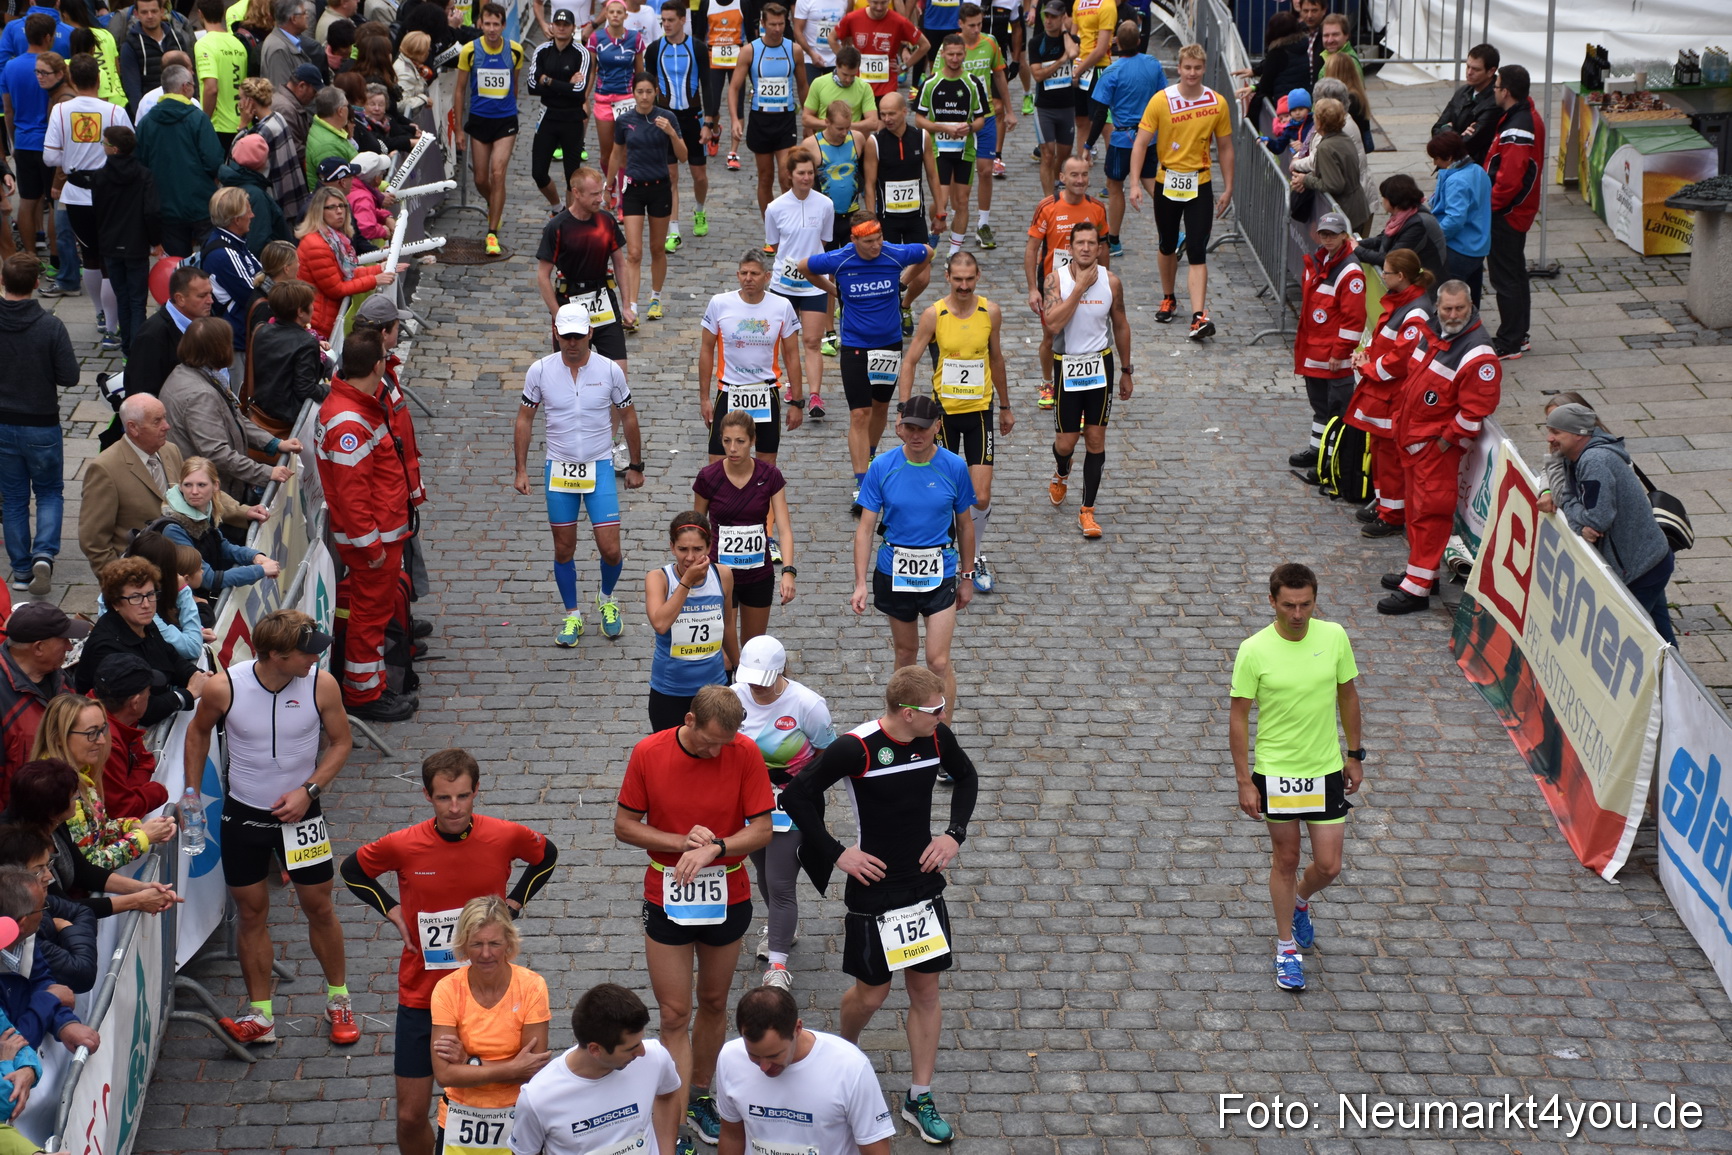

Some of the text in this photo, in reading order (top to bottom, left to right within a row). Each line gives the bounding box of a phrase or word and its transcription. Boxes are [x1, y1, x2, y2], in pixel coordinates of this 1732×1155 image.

[720, 46, 733, 56] 83
[865, 61, 883, 72] 160
[484, 76, 505, 88] 539
[760, 84, 786, 96] 2321
[1171, 108, 1220, 124] MAX BÖGL
[390, 168, 407, 189] BMW
[404, 136, 429, 169] Laufsport
[1170, 177, 1192, 190] 358
[892, 188, 914, 201] 372
[850, 279, 892, 293] SYSCAD
[869, 358, 898, 372] 2771
[1067, 360, 1100, 377] 2207
[960, 369, 970, 384] 2
[1071, 379, 1098, 387] Wolfgang
[952, 386, 975, 394] Thomas
[732, 393, 768, 408] 3004
[561, 462, 587, 478] 128
[563, 480, 581, 488] Frank
[723, 535, 763, 553] 2240
[733, 556, 753, 565] Sarah
[898, 558, 940, 576] 2024
[906, 578, 930, 586] Helmut
[689, 623, 710, 643] 73
[680, 644, 715, 655] Eva-Maria
[1279, 775, 1315, 794] 538
[295, 819, 326, 846] 530
[293, 843, 329, 863] URBEL
[669, 880, 722, 902] 3015
[893, 916, 930, 945] 152
[903, 943, 931, 959] Florian
[448, 1106, 507, 1119] PARTL Neumarkt
[458, 1118, 505, 1145] 507
